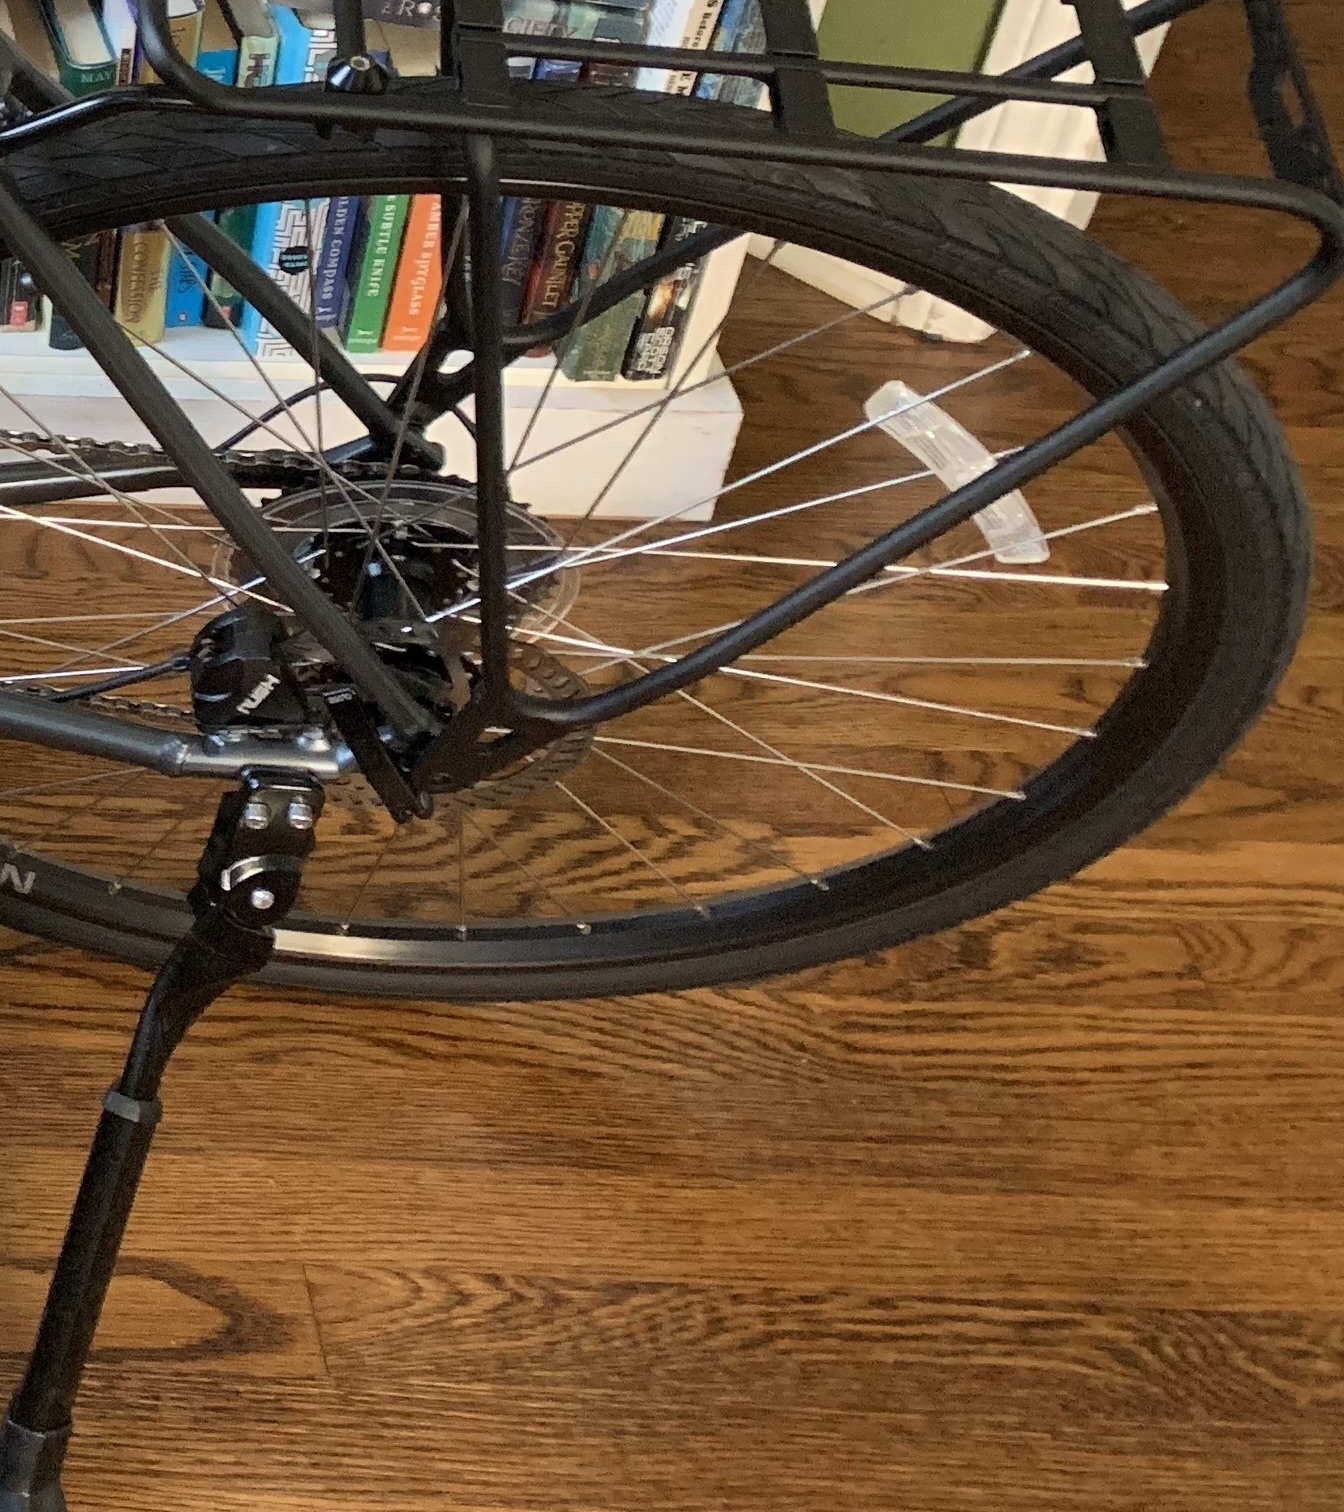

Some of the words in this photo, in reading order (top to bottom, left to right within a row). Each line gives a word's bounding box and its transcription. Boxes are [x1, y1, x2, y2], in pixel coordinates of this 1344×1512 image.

[375, 203, 397, 255] SUBTLE
[321, 239, 342, 300] COMPASS
[368, 258, 385, 297] KNIFE
[408, 252, 431, 315] SPYGLASS
[542, 241, 576, 308] GAUNTLET
[651, 327, 674, 374] ORSON
